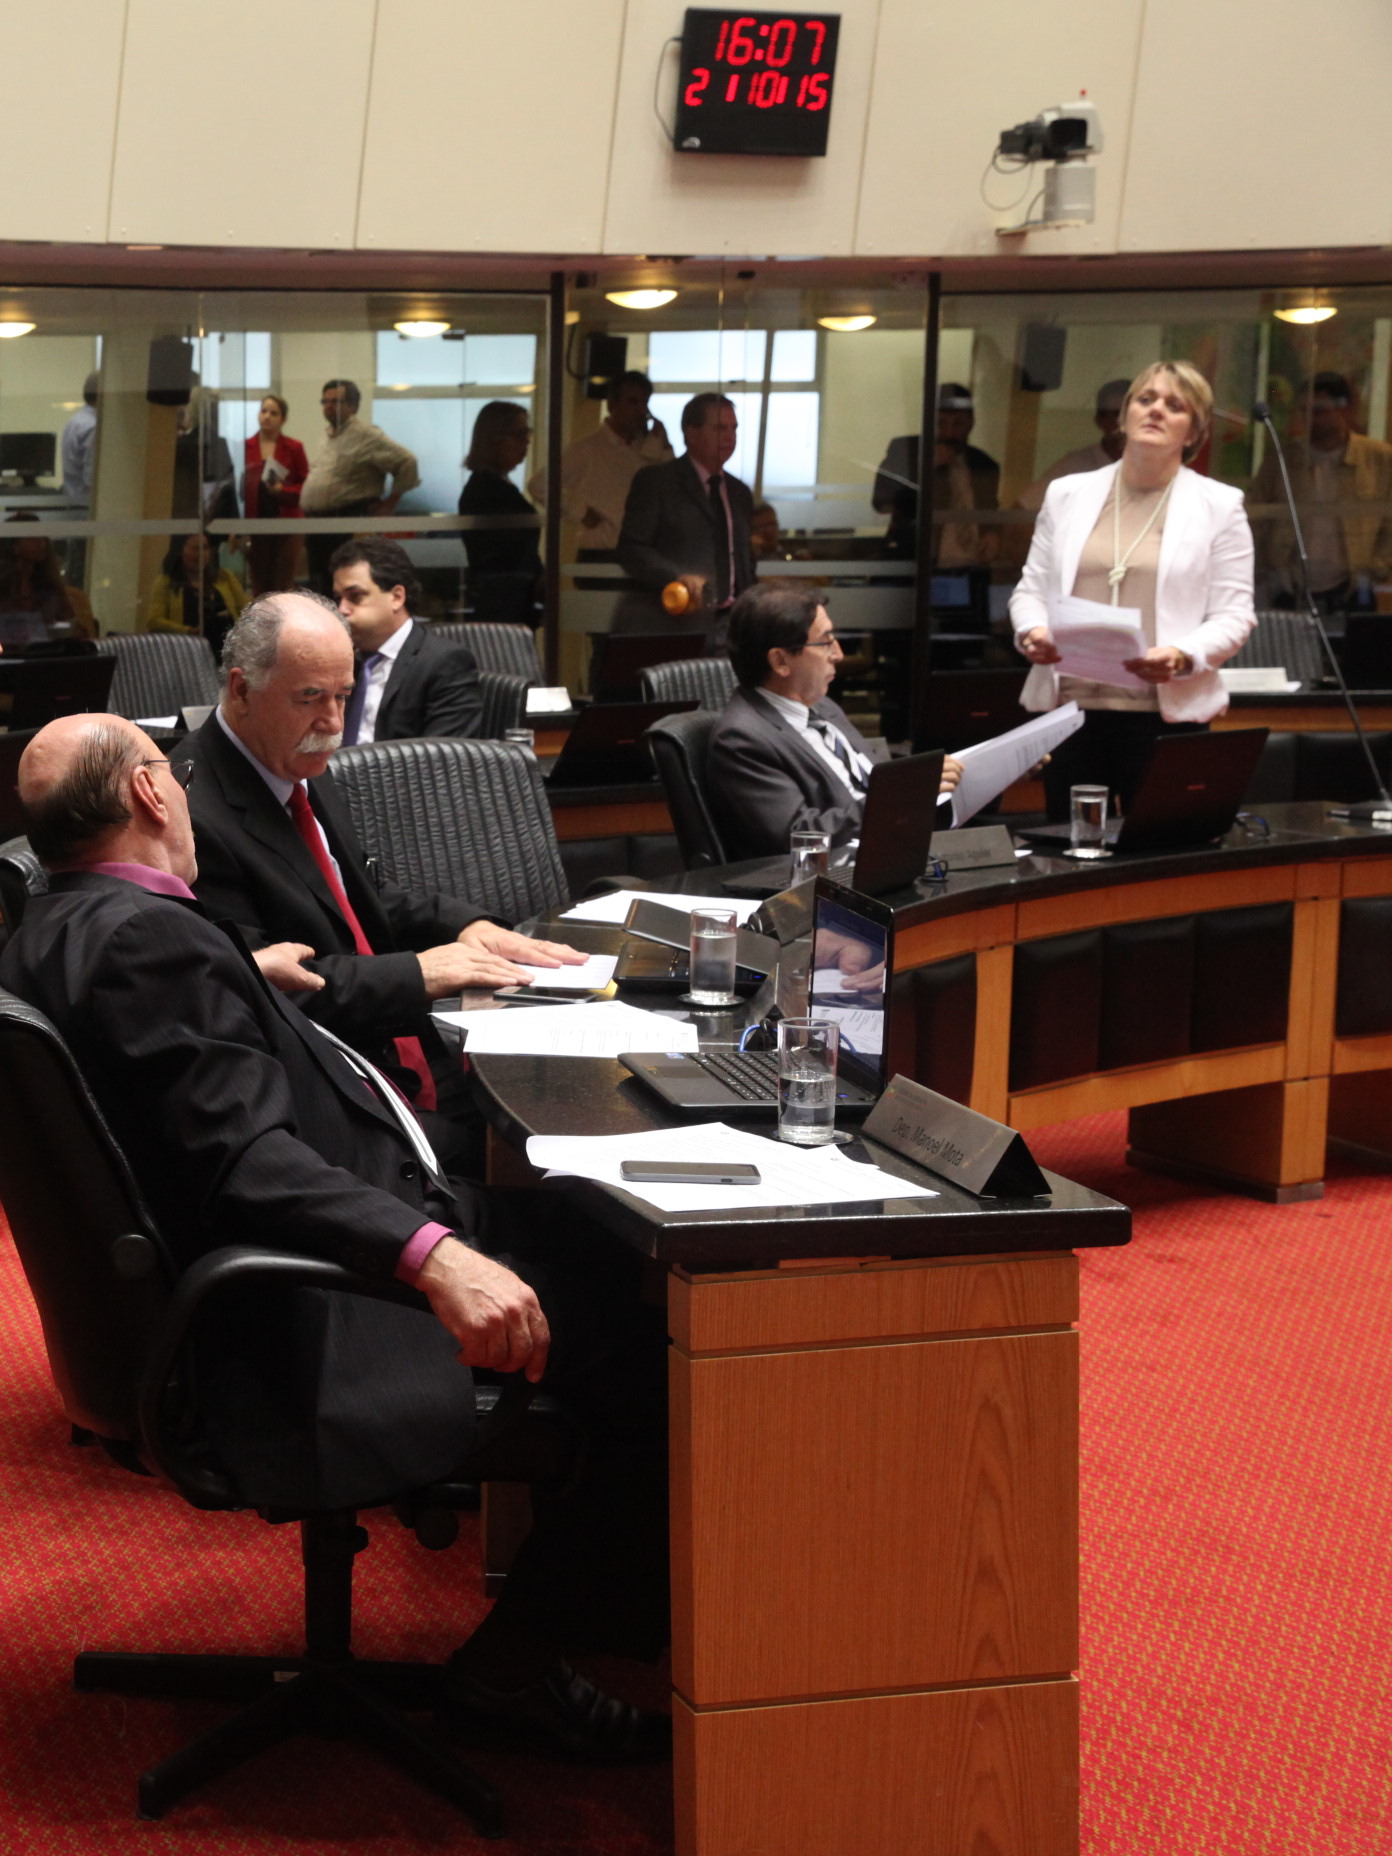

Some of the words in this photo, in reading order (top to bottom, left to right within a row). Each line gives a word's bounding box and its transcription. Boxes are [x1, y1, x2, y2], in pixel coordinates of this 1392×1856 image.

[715, 17, 826, 67] 16:07
[892, 1117, 911, 1138] Dep.
[910, 1126, 946, 1155] Manoel
[940, 1141, 964, 1167] Mota
